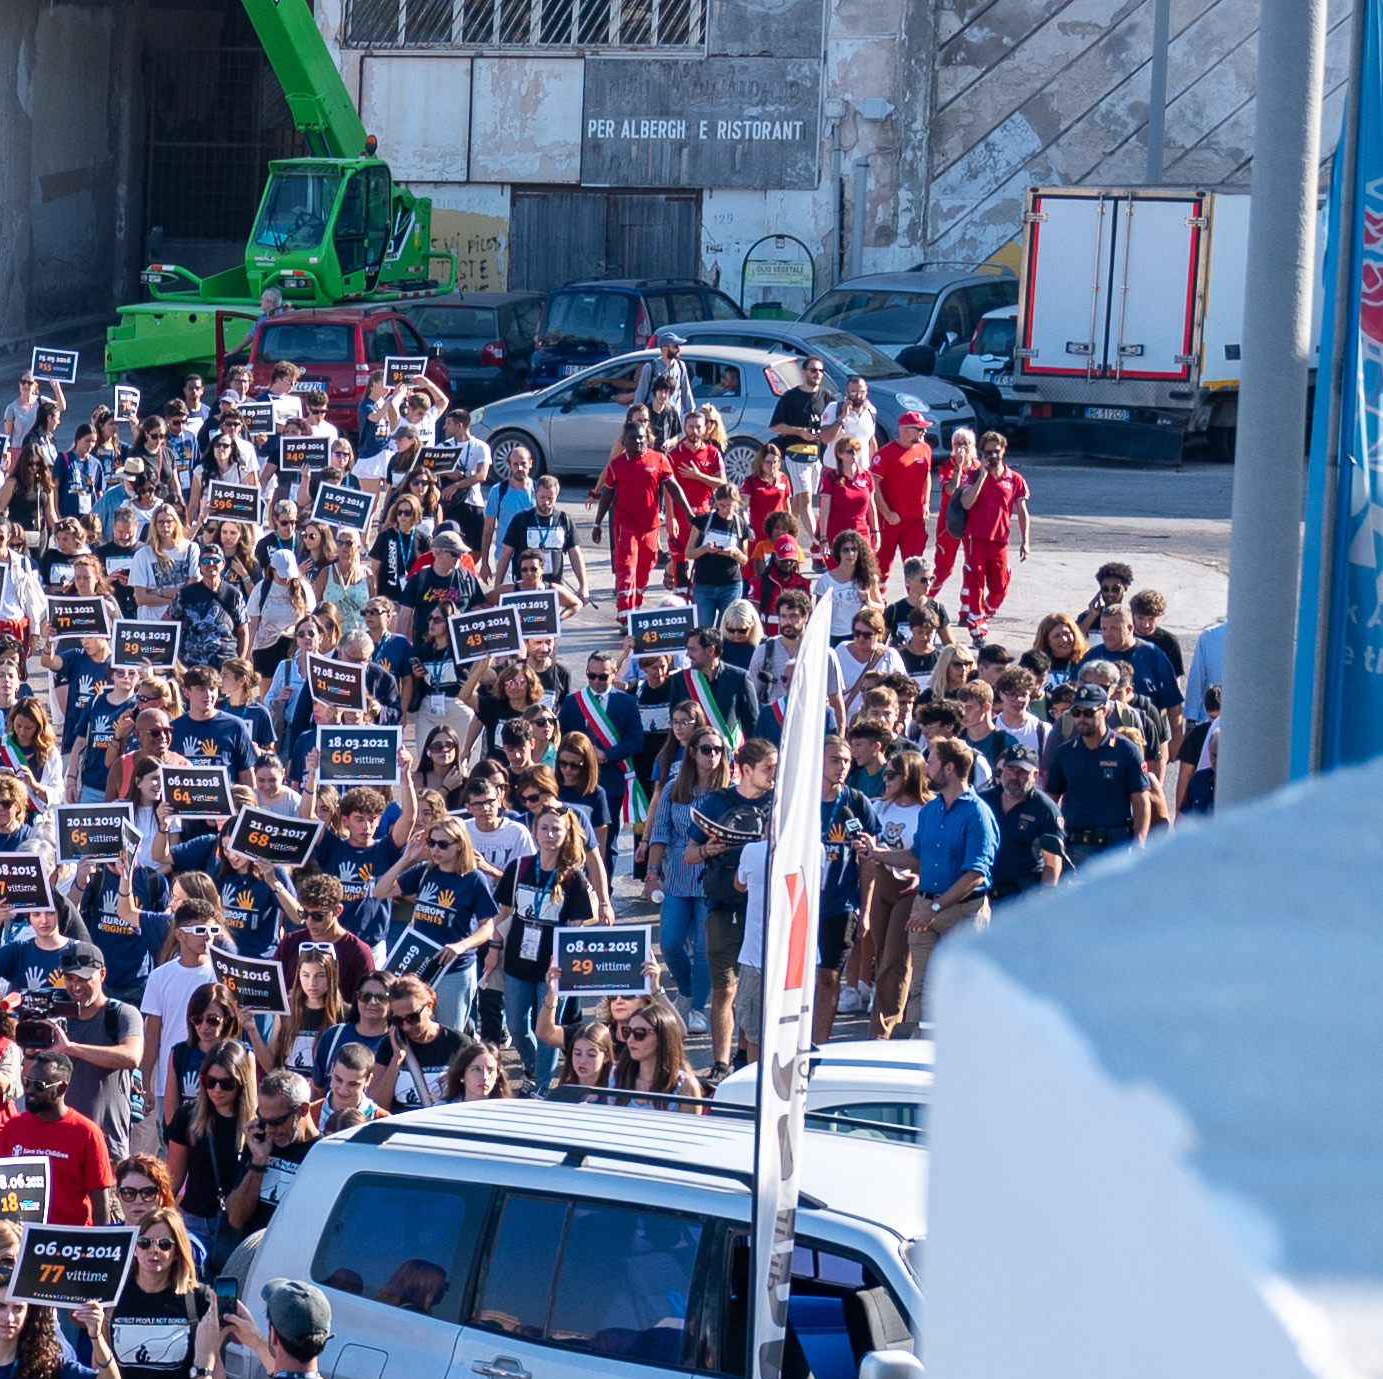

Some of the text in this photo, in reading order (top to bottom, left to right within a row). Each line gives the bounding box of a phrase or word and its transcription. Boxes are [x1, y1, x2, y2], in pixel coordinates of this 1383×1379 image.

[588, 120, 614, 139] PER
[699, 122, 708, 139] E
[58, 617, 71, 628] 77
[458, 616, 511, 633] 21.09.2014
[121, 630, 171, 643] 25.04.2023
[466, 633, 483, 647] 43
[642, 630, 658, 643] 43
[124, 642, 166, 655] 29 vittime
[317, 680, 327, 690] 21
[328, 738, 390, 750] 18.03.2021
[332, 750, 386, 765] 66 vittime
[168, 776, 220, 789] 06.01.2018
[174, 788, 219, 805] 64 vittime
[66, 816, 122, 829] 20.11.2019
[250, 820, 308, 840] 21.03.2017
[71, 829, 119, 846] 65 vittime
[248, 832, 269, 847] 68
[7, 882, 37, 893] vittime
[566, 940, 638, 956] 08.02.2015
[216, 961, 271, 983] 09.11.2016
[572, 958, 631, 975] 29 vittime
[237, 985, 270, 998] vittime
[0, 1192, 18, 1213] 18
[34, 1241, 122, 1262] 06.05.2014
[38, 1264, 109, 1284] 77 vittime
